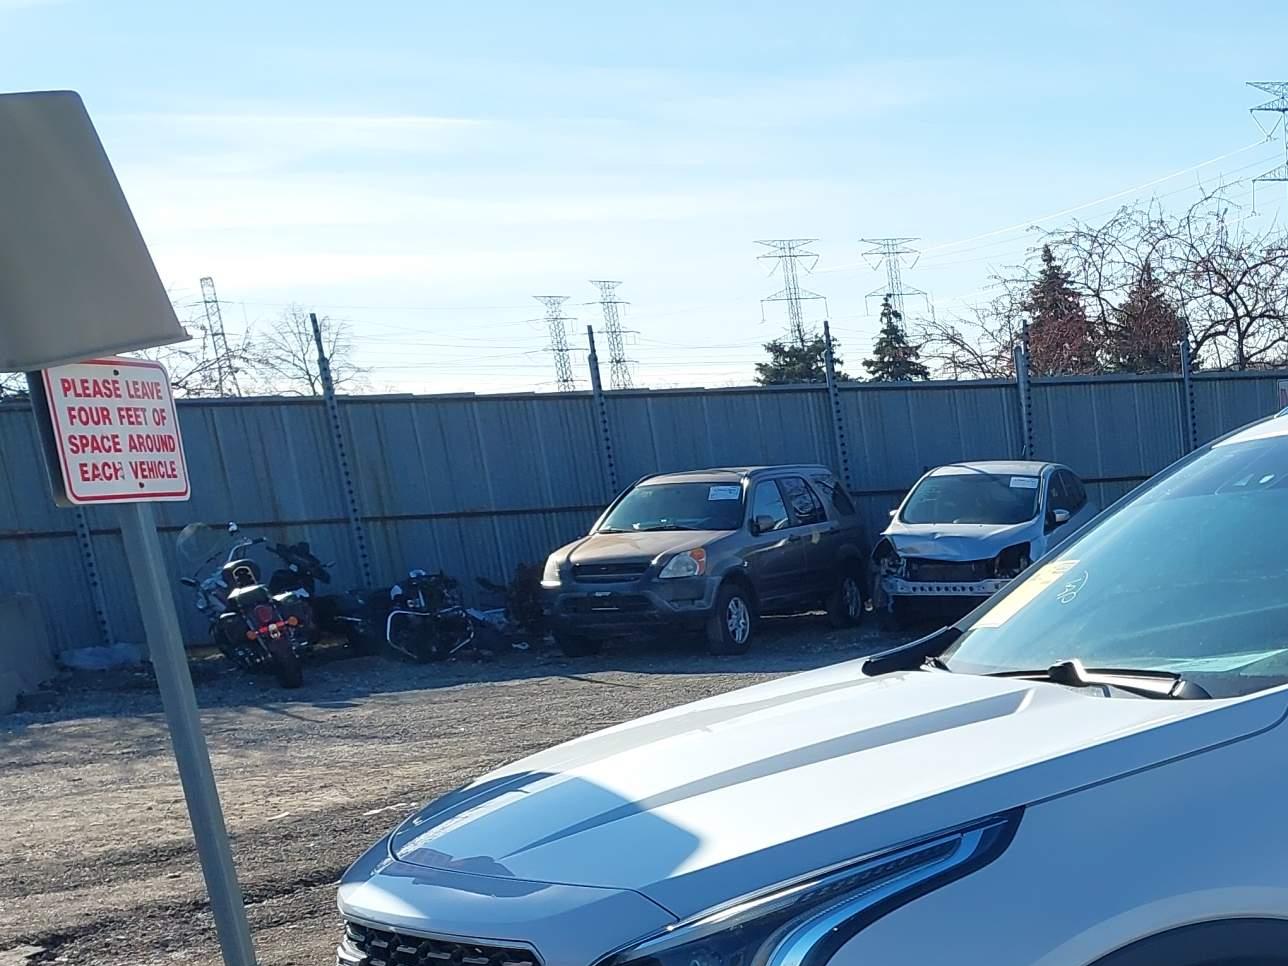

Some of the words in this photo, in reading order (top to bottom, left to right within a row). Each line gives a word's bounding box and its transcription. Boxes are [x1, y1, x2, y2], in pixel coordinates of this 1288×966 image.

[61, 379, 122, 398] PLEASE
[127, 380, 162, 399] LEAVE
[68, 407, 112, 425] FOUR
[118, 408, 148, 425] FEET
[152, 408, 167, 426] OF
[68, 434, 122, 454] SPACE
[128, 434, 176, 453] AROUND
[80, 462, 125, 481] EACH
[129, 461, 178, 479] VEHICLE
